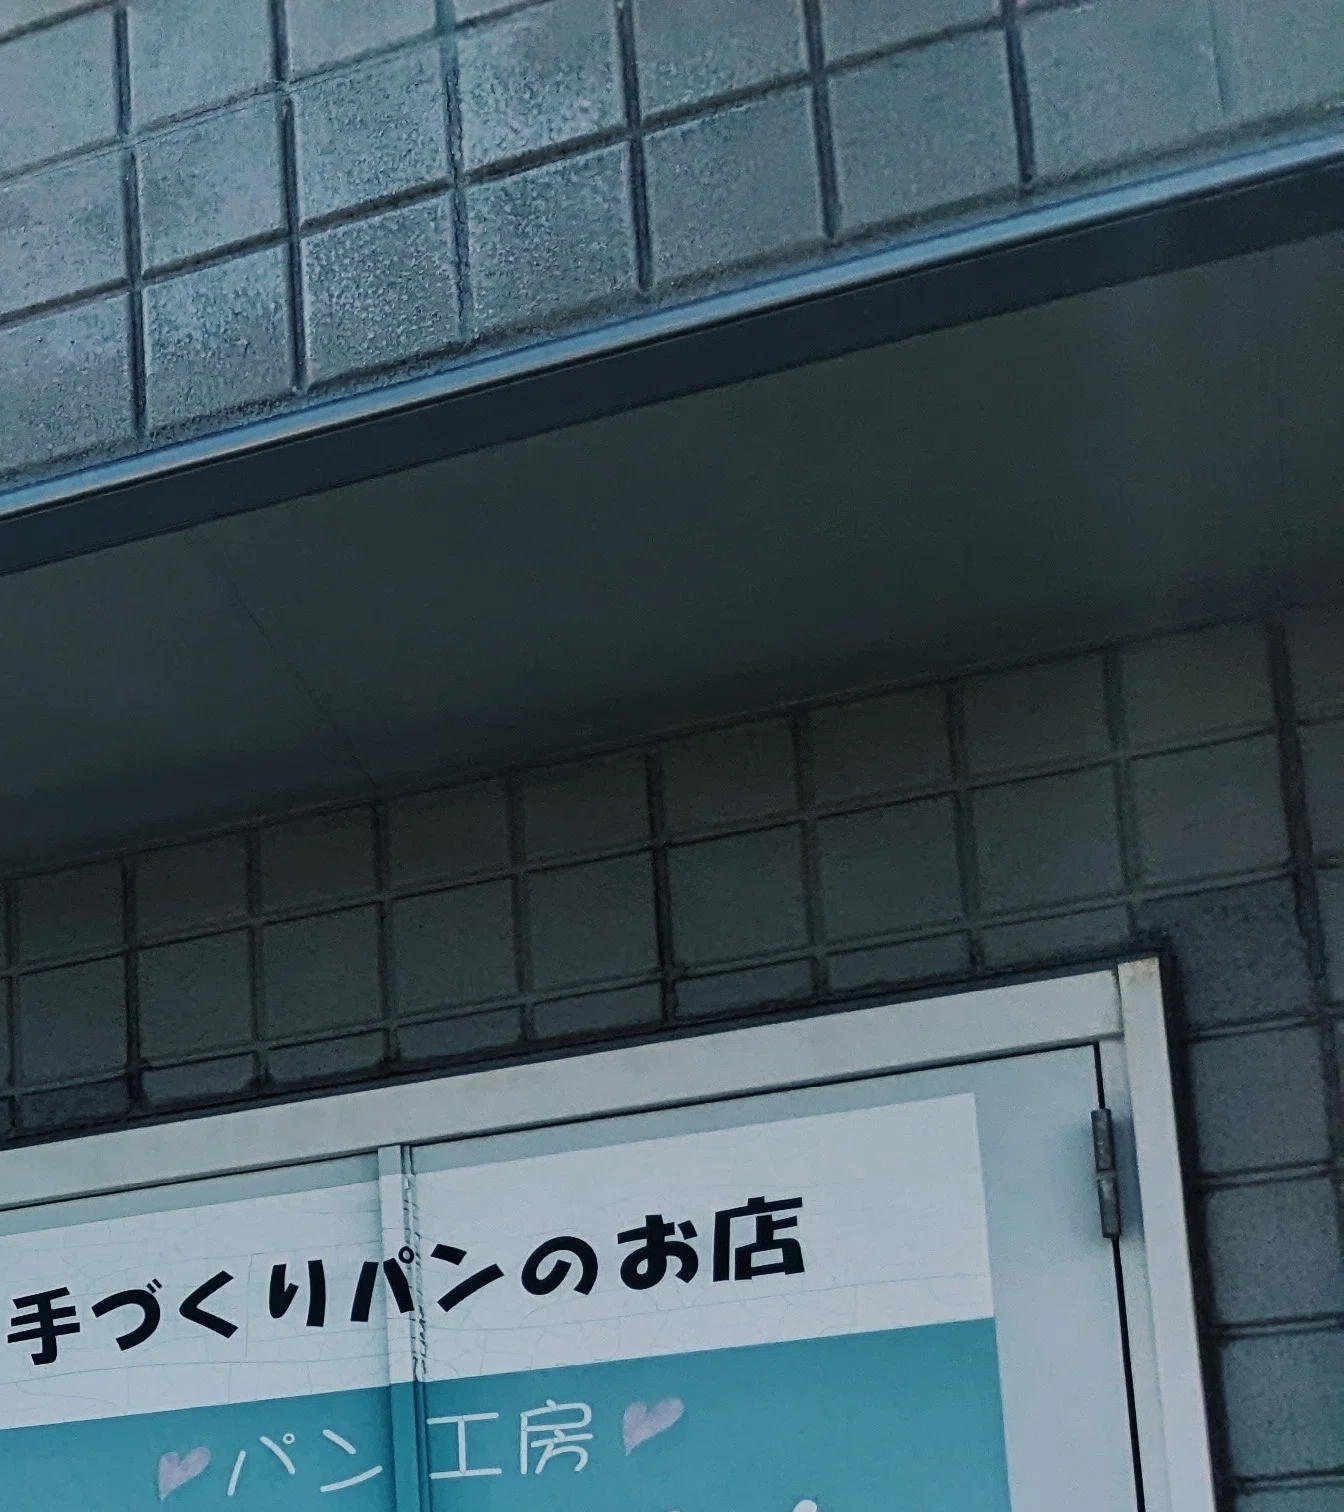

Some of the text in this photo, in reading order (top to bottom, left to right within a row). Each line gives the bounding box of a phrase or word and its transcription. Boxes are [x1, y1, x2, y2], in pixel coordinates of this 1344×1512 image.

[7, 1196, 806, 1366] 手づくりパンのお店
[226, 1398, 593, 1496] パン工房
